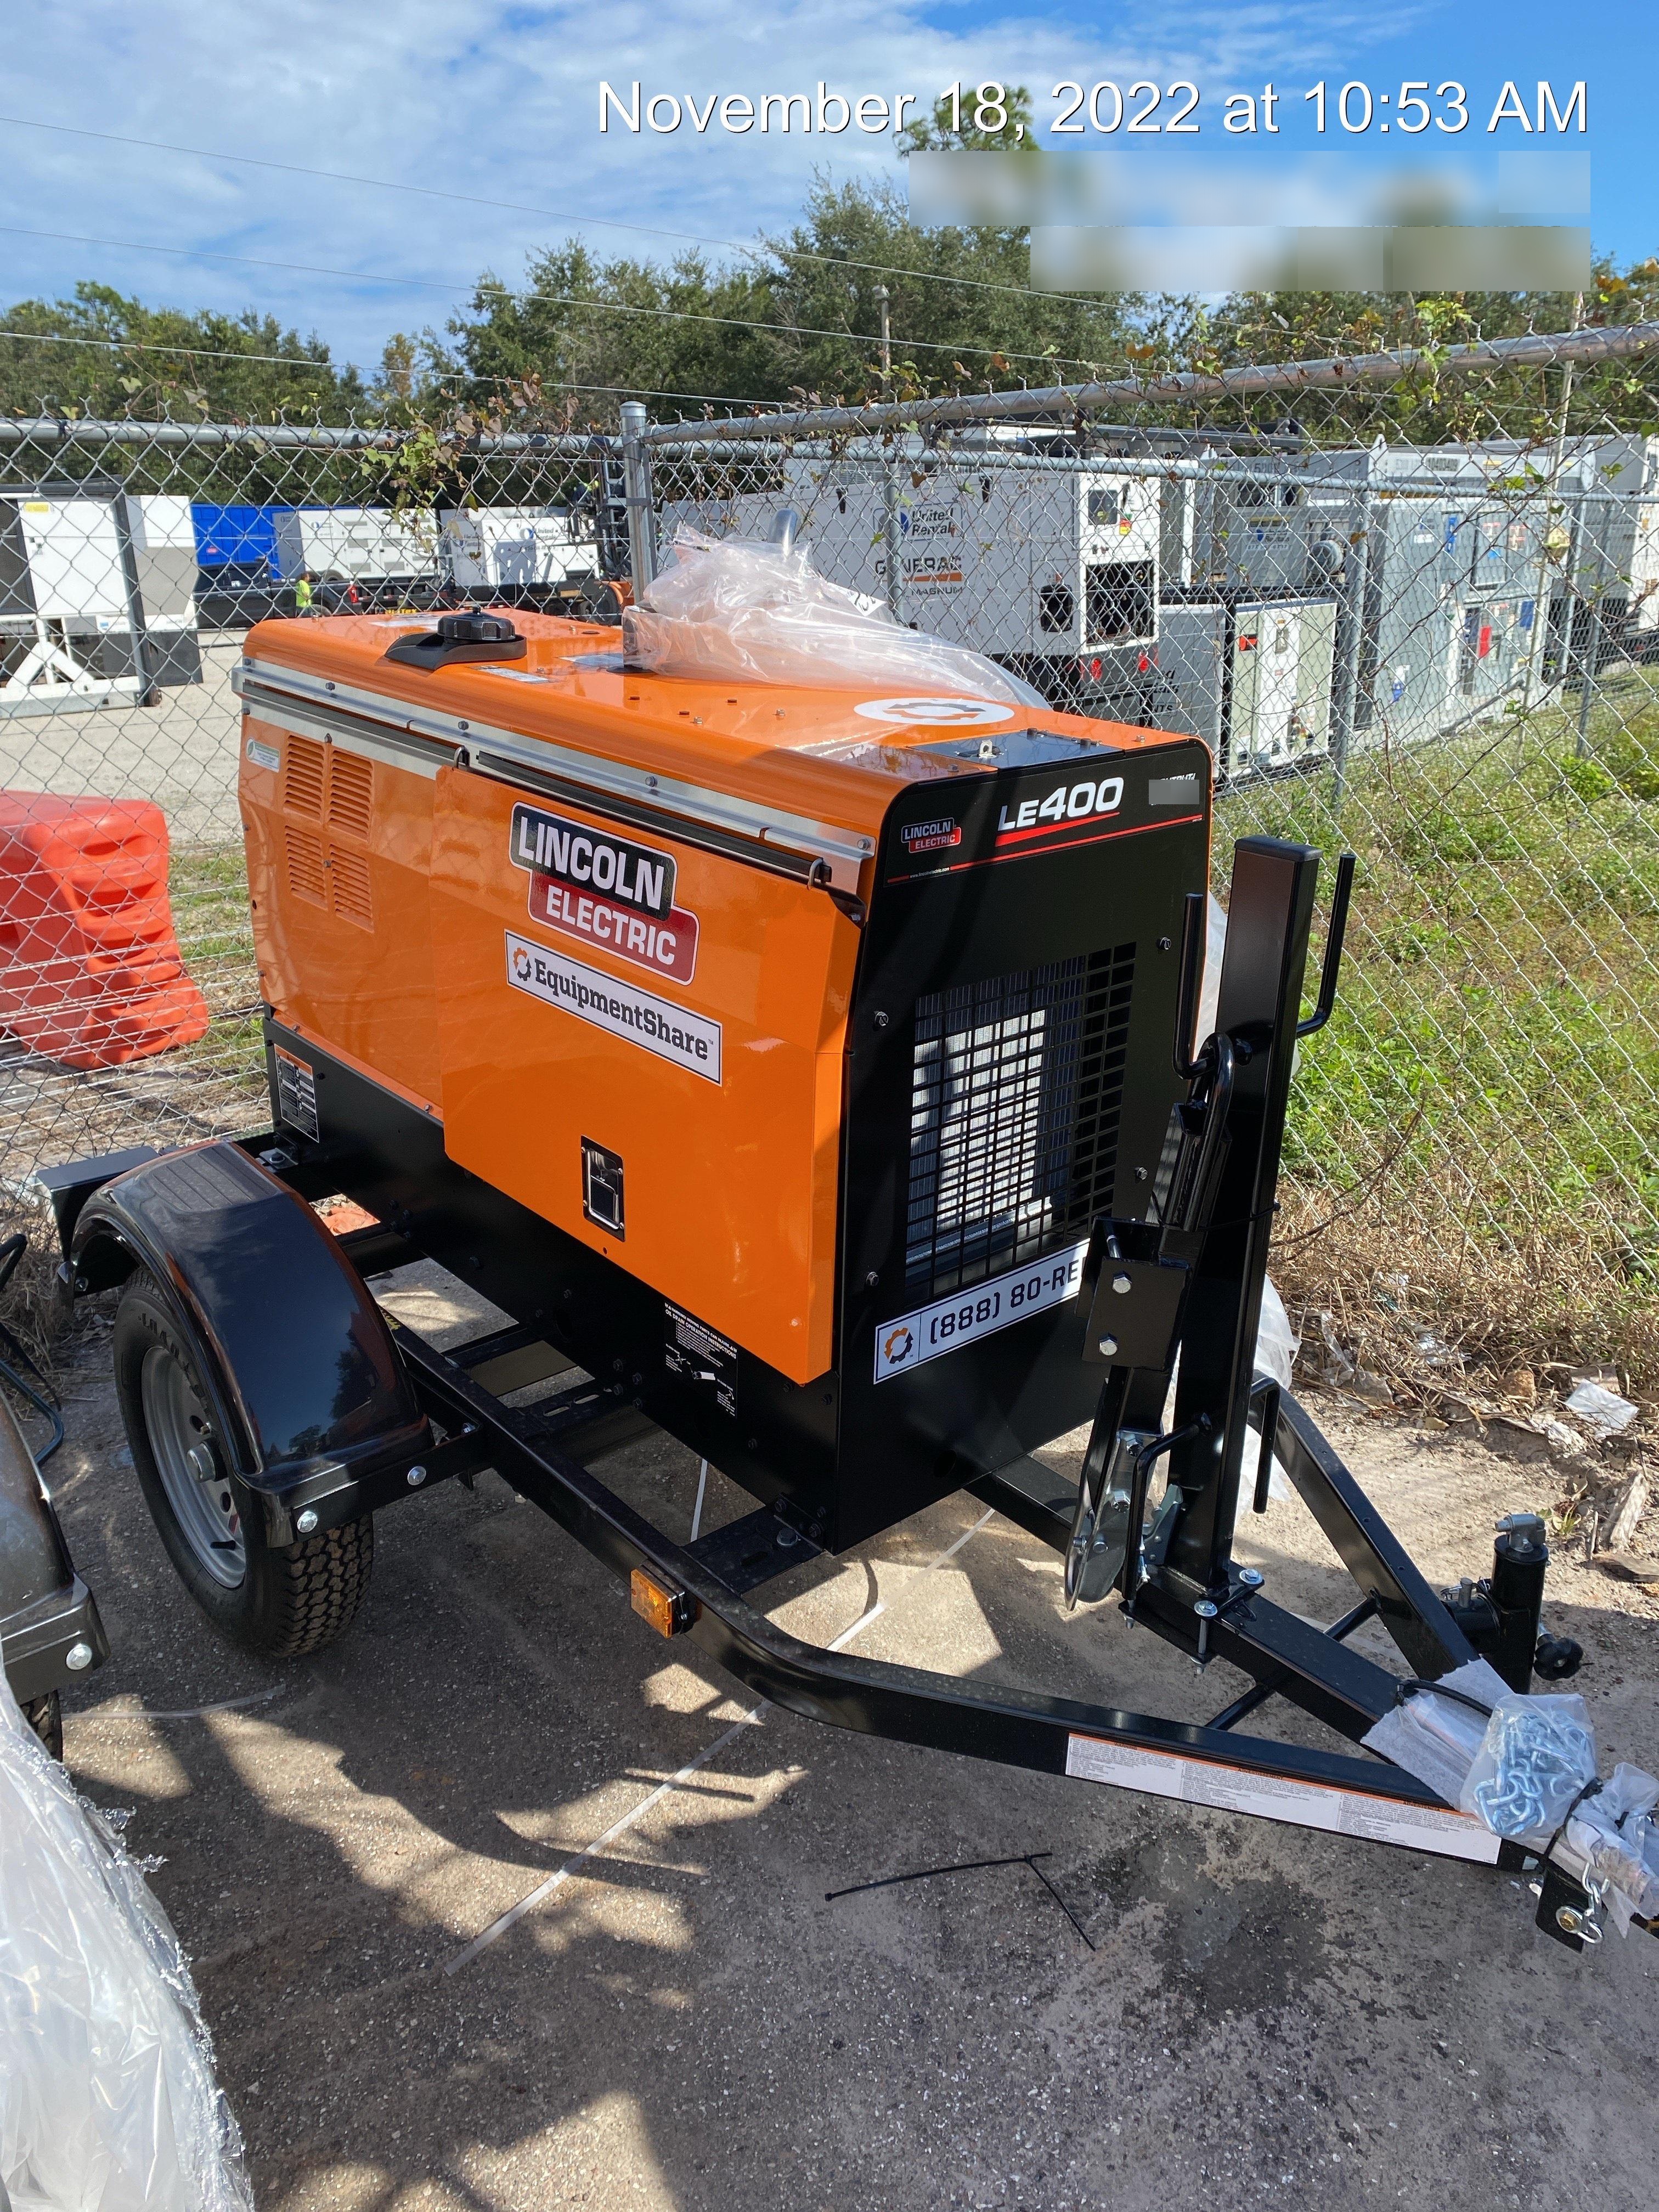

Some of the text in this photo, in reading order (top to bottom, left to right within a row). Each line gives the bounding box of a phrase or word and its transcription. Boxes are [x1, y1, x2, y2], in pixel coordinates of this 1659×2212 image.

[912, 508, 953, 522] United
[912, 522, 955, 537] Rental
[875, 556, 962, 574] GNERAC
[912, 586, 963, 596] MAGNUM
[997, 777, 1125, 832] LE400
[905, 821, 951, 840] LINCOLN
[915, 834, 956, 850] ELECTRIC
[518, 816, 665, 910] LINCOLN
[910, 867, 950, 878] www.lincolnelectric.com
[546, 884, 677, 966] ELECTRIC
[534, 957, 708, 1061] EquipmentShare
[930, 1291, 1001, 1345] (888)
